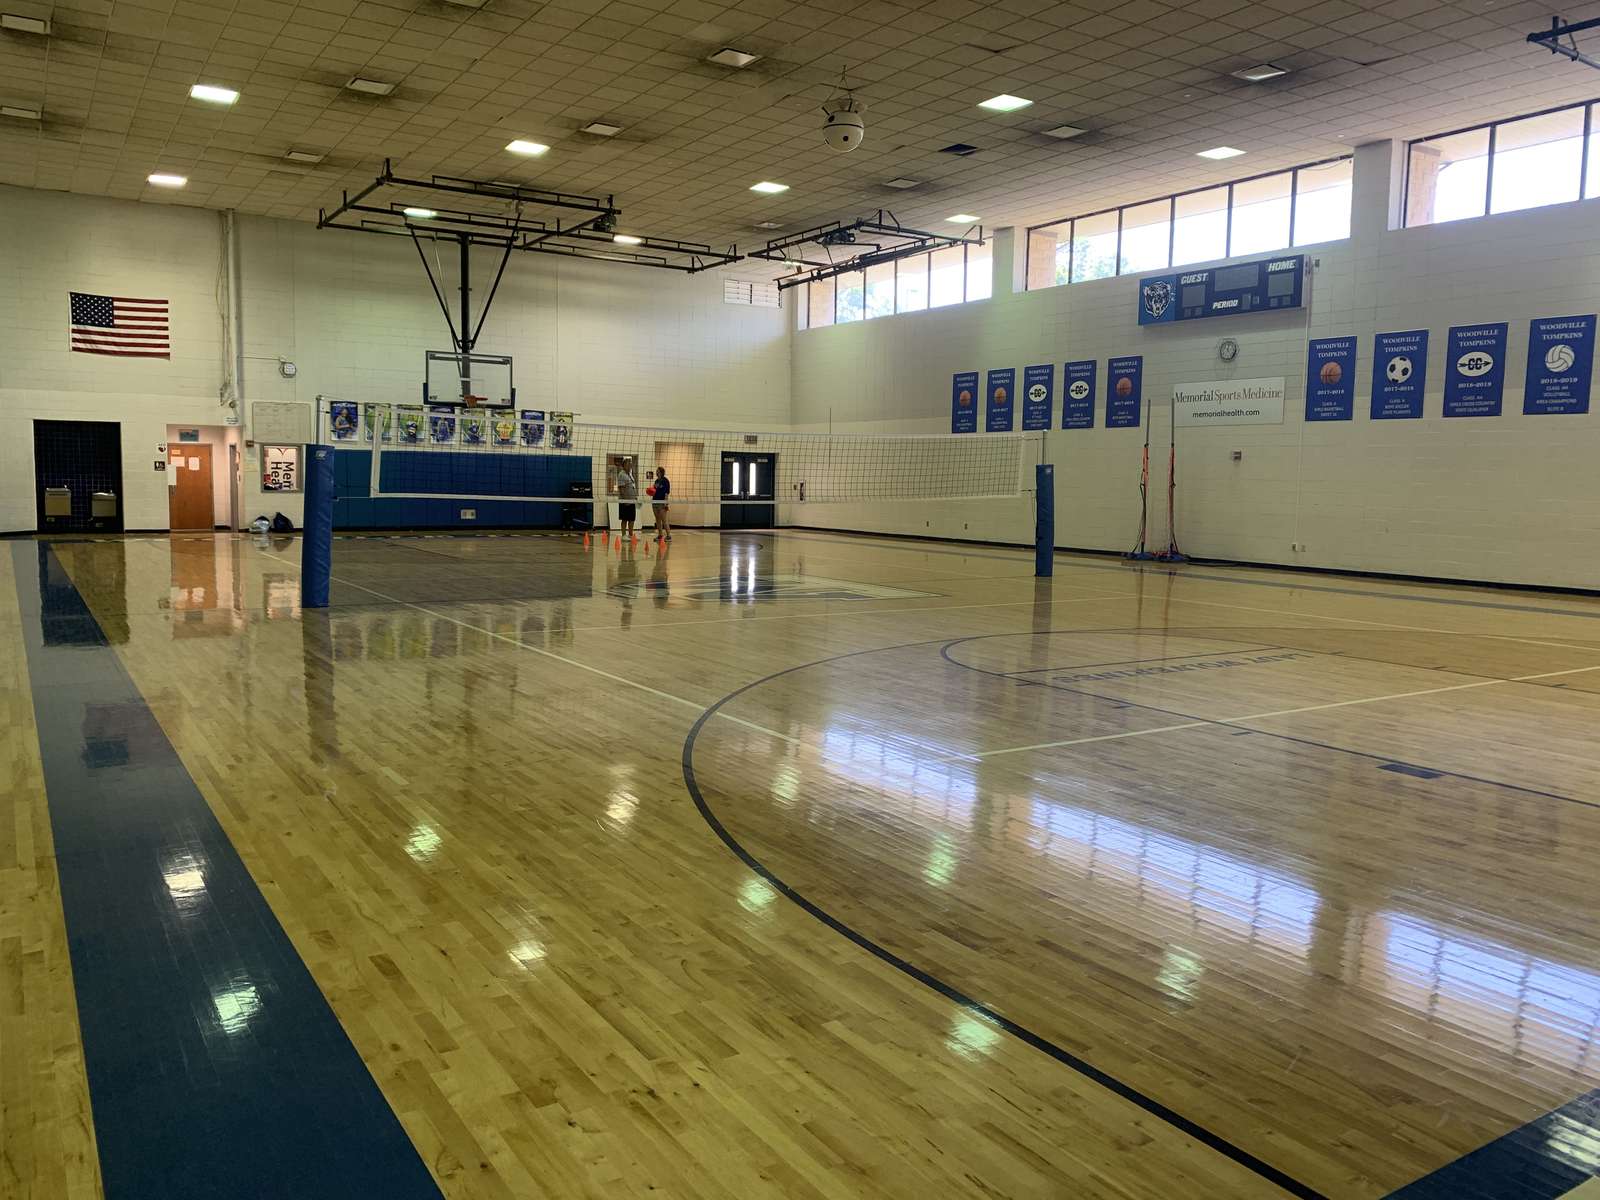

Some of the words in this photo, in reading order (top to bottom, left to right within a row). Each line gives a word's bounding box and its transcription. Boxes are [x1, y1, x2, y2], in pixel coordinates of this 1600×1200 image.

[1268, 260, 1297, 272] HOME
[1181, 273, 1208, 285] GUEST
[1212, 299, 1239, 309] PERIOD
[1540, 322, 1587, 331] WOODVILLE
[1457, 329, 1500, 338] WOODVILLE
[1542, 332, 1583, 340] TOMPKINS
[1382, 336, 1421, 344] WOODVILLE
[1458, 339, 1496, 347] TOMPKINS
[1315, 342, 1350, 350] WOODVILLE
[1318, 350, 1348, 359] TOMPKINS
[1175, 390, 1214, 402] Memorial
[1214, 390, 1240, 404] Sports
[1242, 387, 1282, 400] Medicine
[1192, 409, 1260, 418] memorialhealth.com
